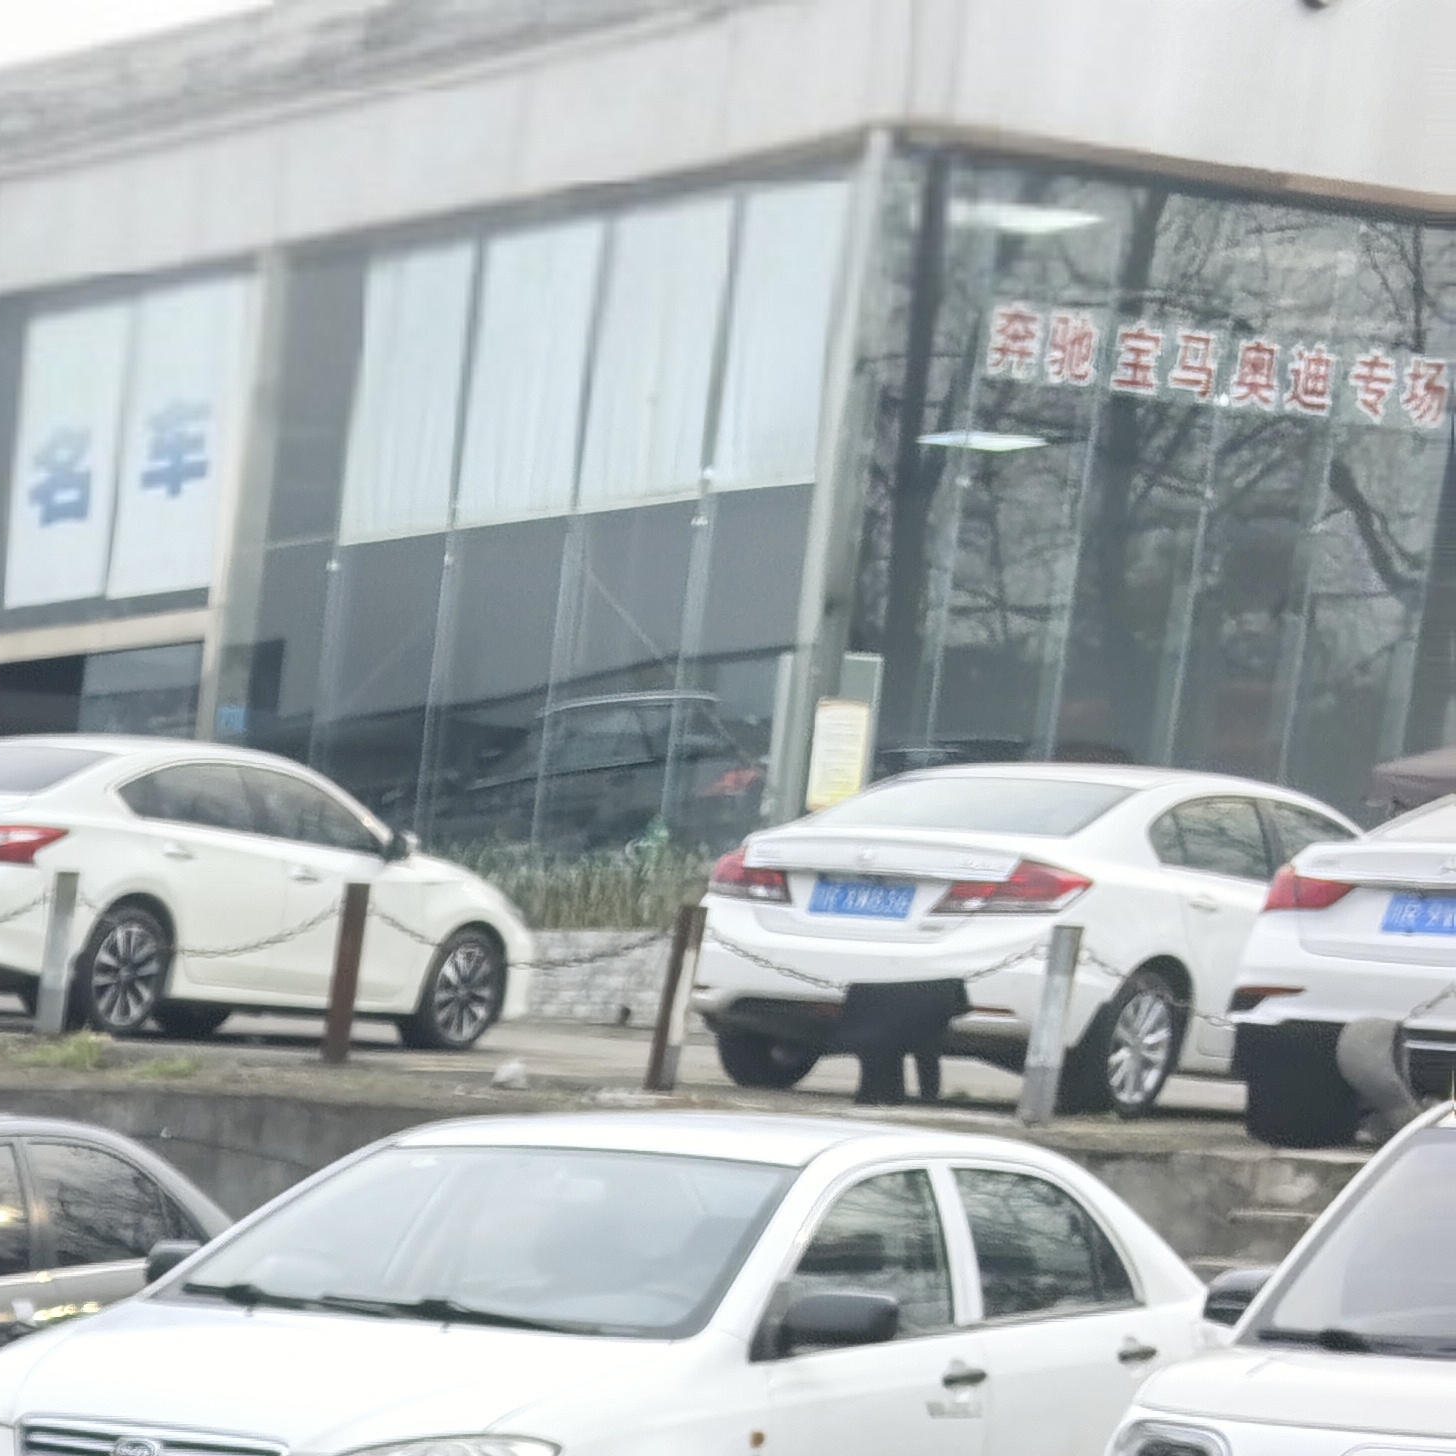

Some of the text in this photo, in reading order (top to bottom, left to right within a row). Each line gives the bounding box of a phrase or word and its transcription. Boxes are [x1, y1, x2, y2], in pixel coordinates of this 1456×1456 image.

[988, 302, 1448, 430] 奔驰宝马奥迪专场
